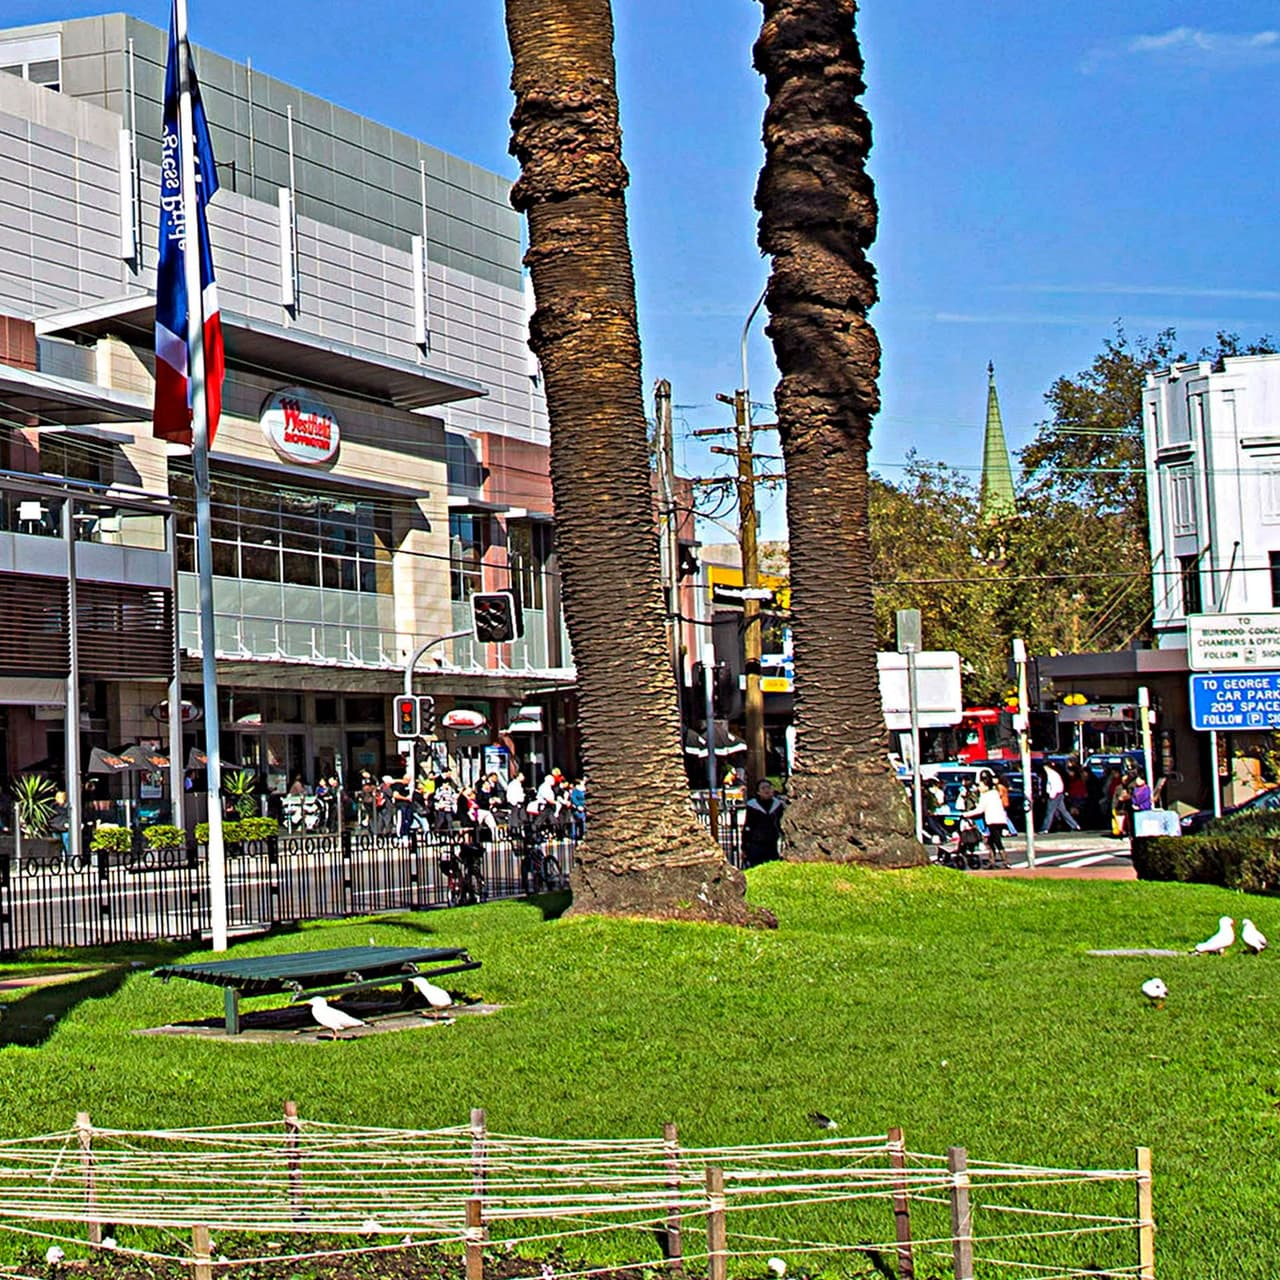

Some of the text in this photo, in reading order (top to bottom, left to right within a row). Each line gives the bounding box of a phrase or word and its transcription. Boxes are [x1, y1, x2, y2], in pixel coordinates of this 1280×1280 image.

[1238, 617, 1251, 625] TO
[1197, 638, 1246, 647] CHAMBERS
[1204, 651, 1239, 659] FOLLOW
[1202, 680, 1217, 690] TO
[1223, 678, 1271, 689] GEORGE
[1216, 690, 1280, 700] CAR PARK
[1211, 703, 1234, 713] 205
[1203, 714, 1243, 725] FOLLOW
